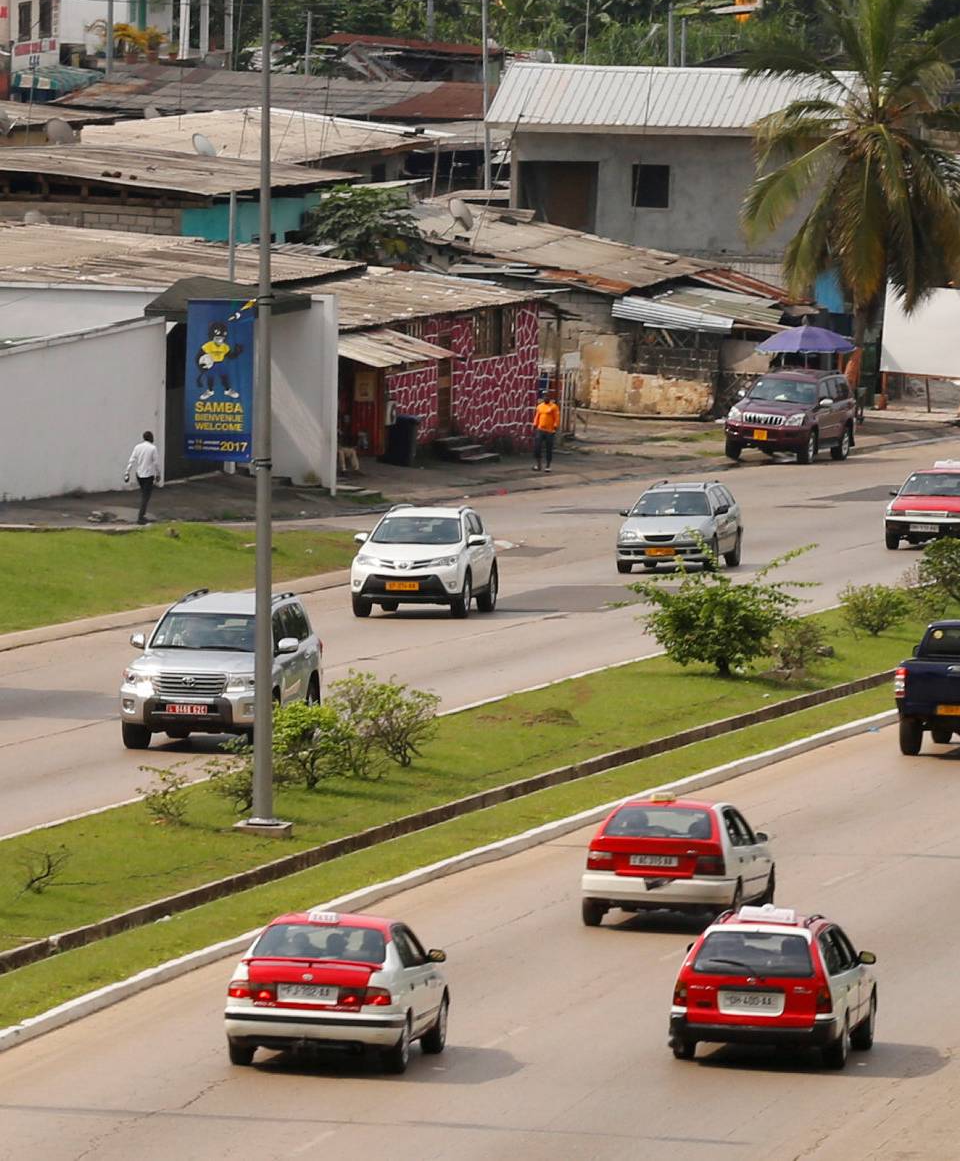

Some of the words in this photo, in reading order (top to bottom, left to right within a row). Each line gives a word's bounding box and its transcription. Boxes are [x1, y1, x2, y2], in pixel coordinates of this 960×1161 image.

[195, 401, 243, 412] SAMBA
[194, 413, 243, 422] BIENVENUE
[195, 422, 244, 431] WELCOME
[220, 441, 248, 452] 2017
